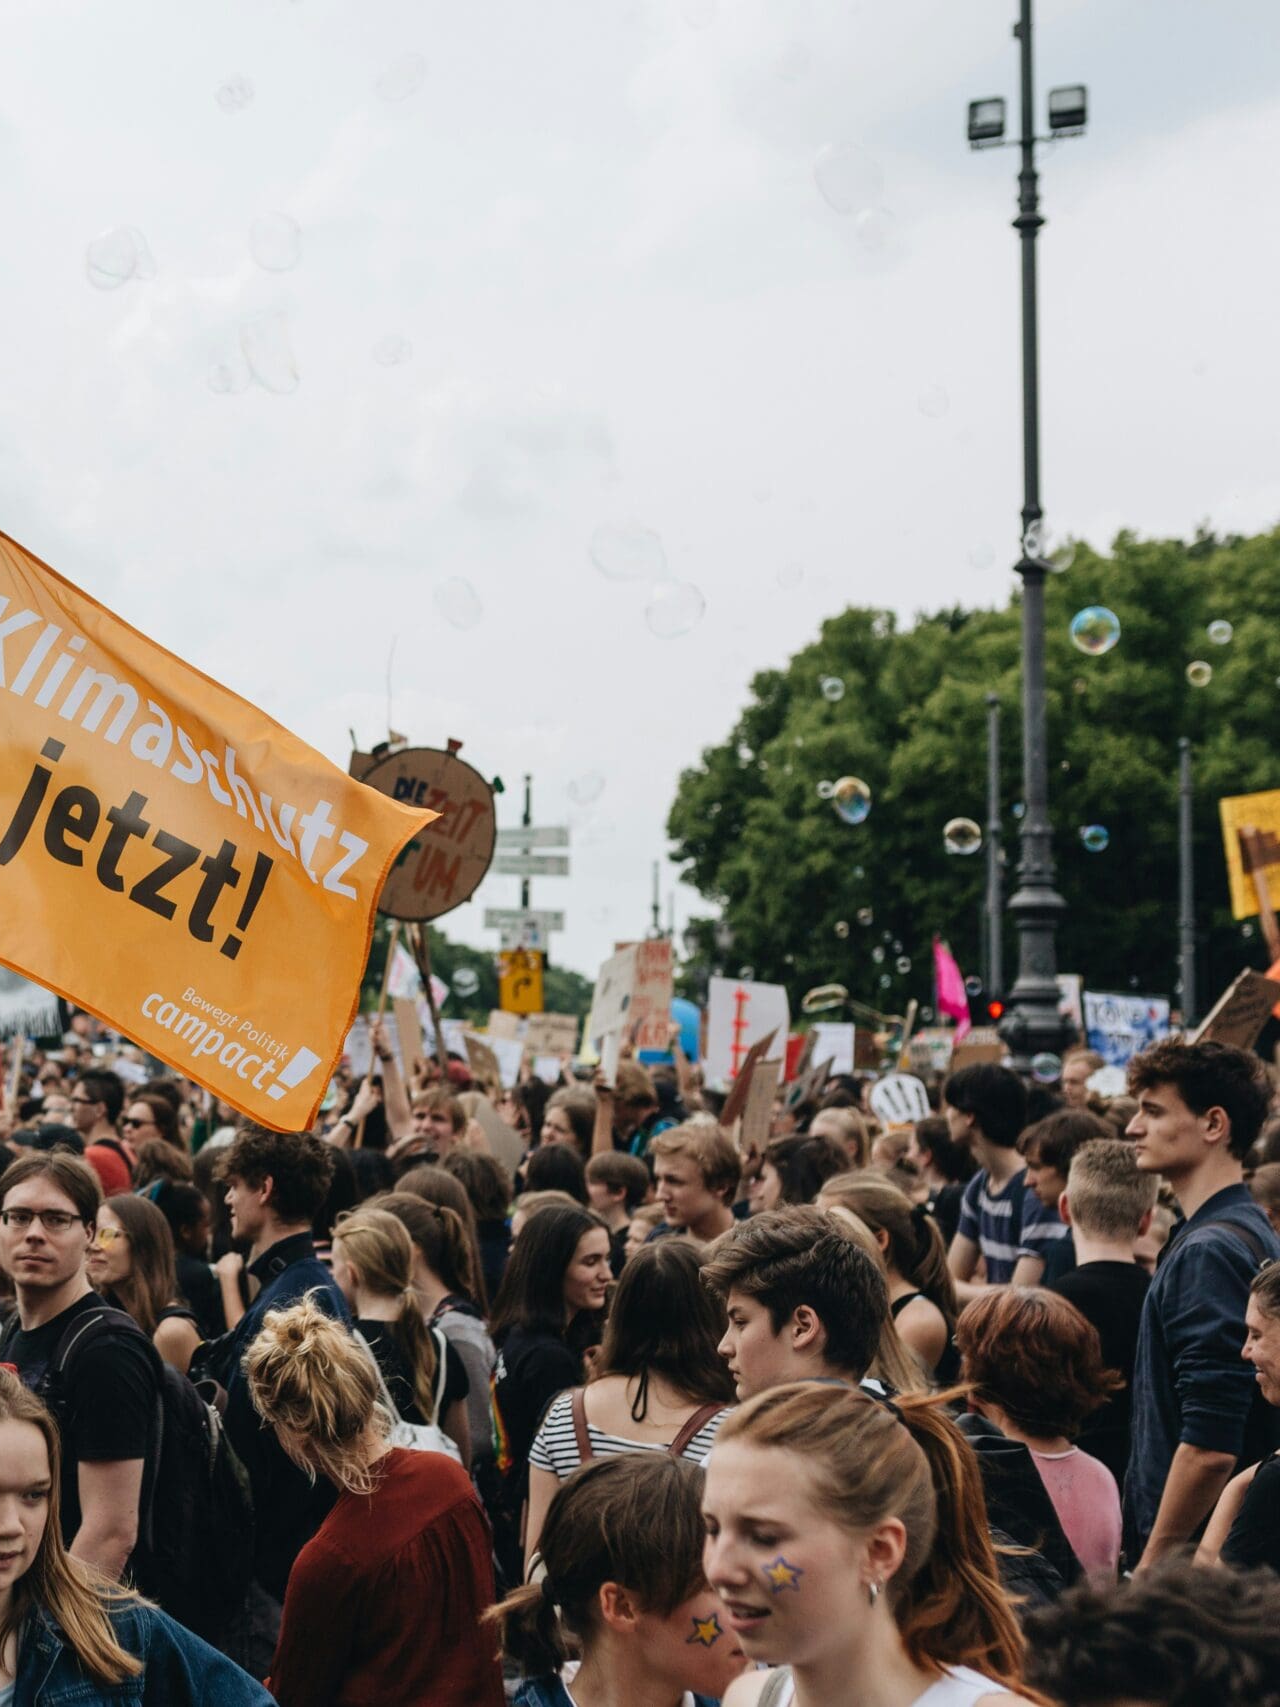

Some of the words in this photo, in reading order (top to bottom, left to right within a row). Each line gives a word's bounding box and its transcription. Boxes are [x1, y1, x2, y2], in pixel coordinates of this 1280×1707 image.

[140, 992, 322, 1101] campact!
[181, 986, 239, 1029] Bewegt
[237, 1020, 290, 1062] Politik
